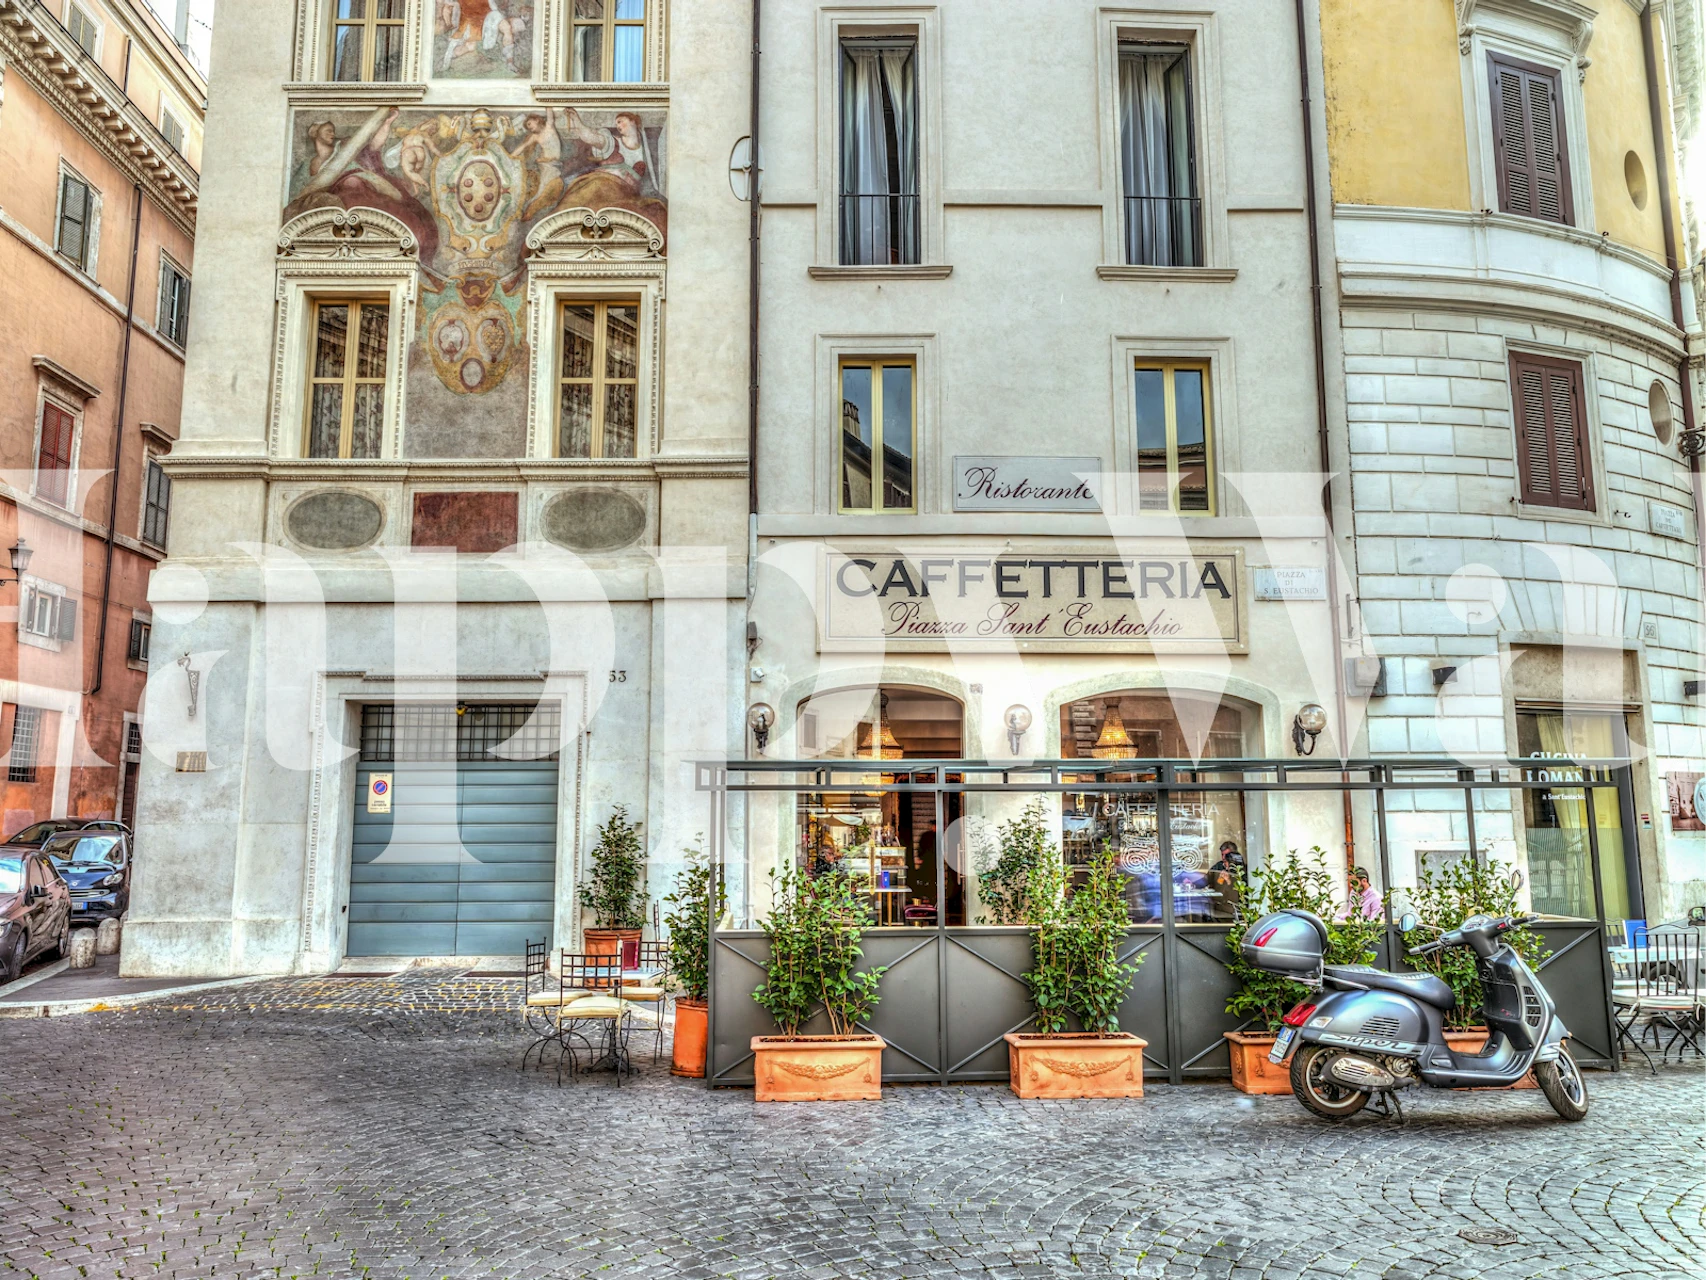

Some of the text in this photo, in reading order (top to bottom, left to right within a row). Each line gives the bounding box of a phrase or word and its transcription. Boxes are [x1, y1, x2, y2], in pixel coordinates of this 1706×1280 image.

[958, 466, 1094, 500] Ristorante
[836, 558, 1232, 599] CAFFETTERIA
[1273, 587, 1319, 595] EUSTACHIO
[881, 601, 968, 637] Piazza
[608, 670, 627, 683] 53
[1102, 801, 1220, 816] CAFFETERIA
[1326, 1034, 1407, 1050] Super
